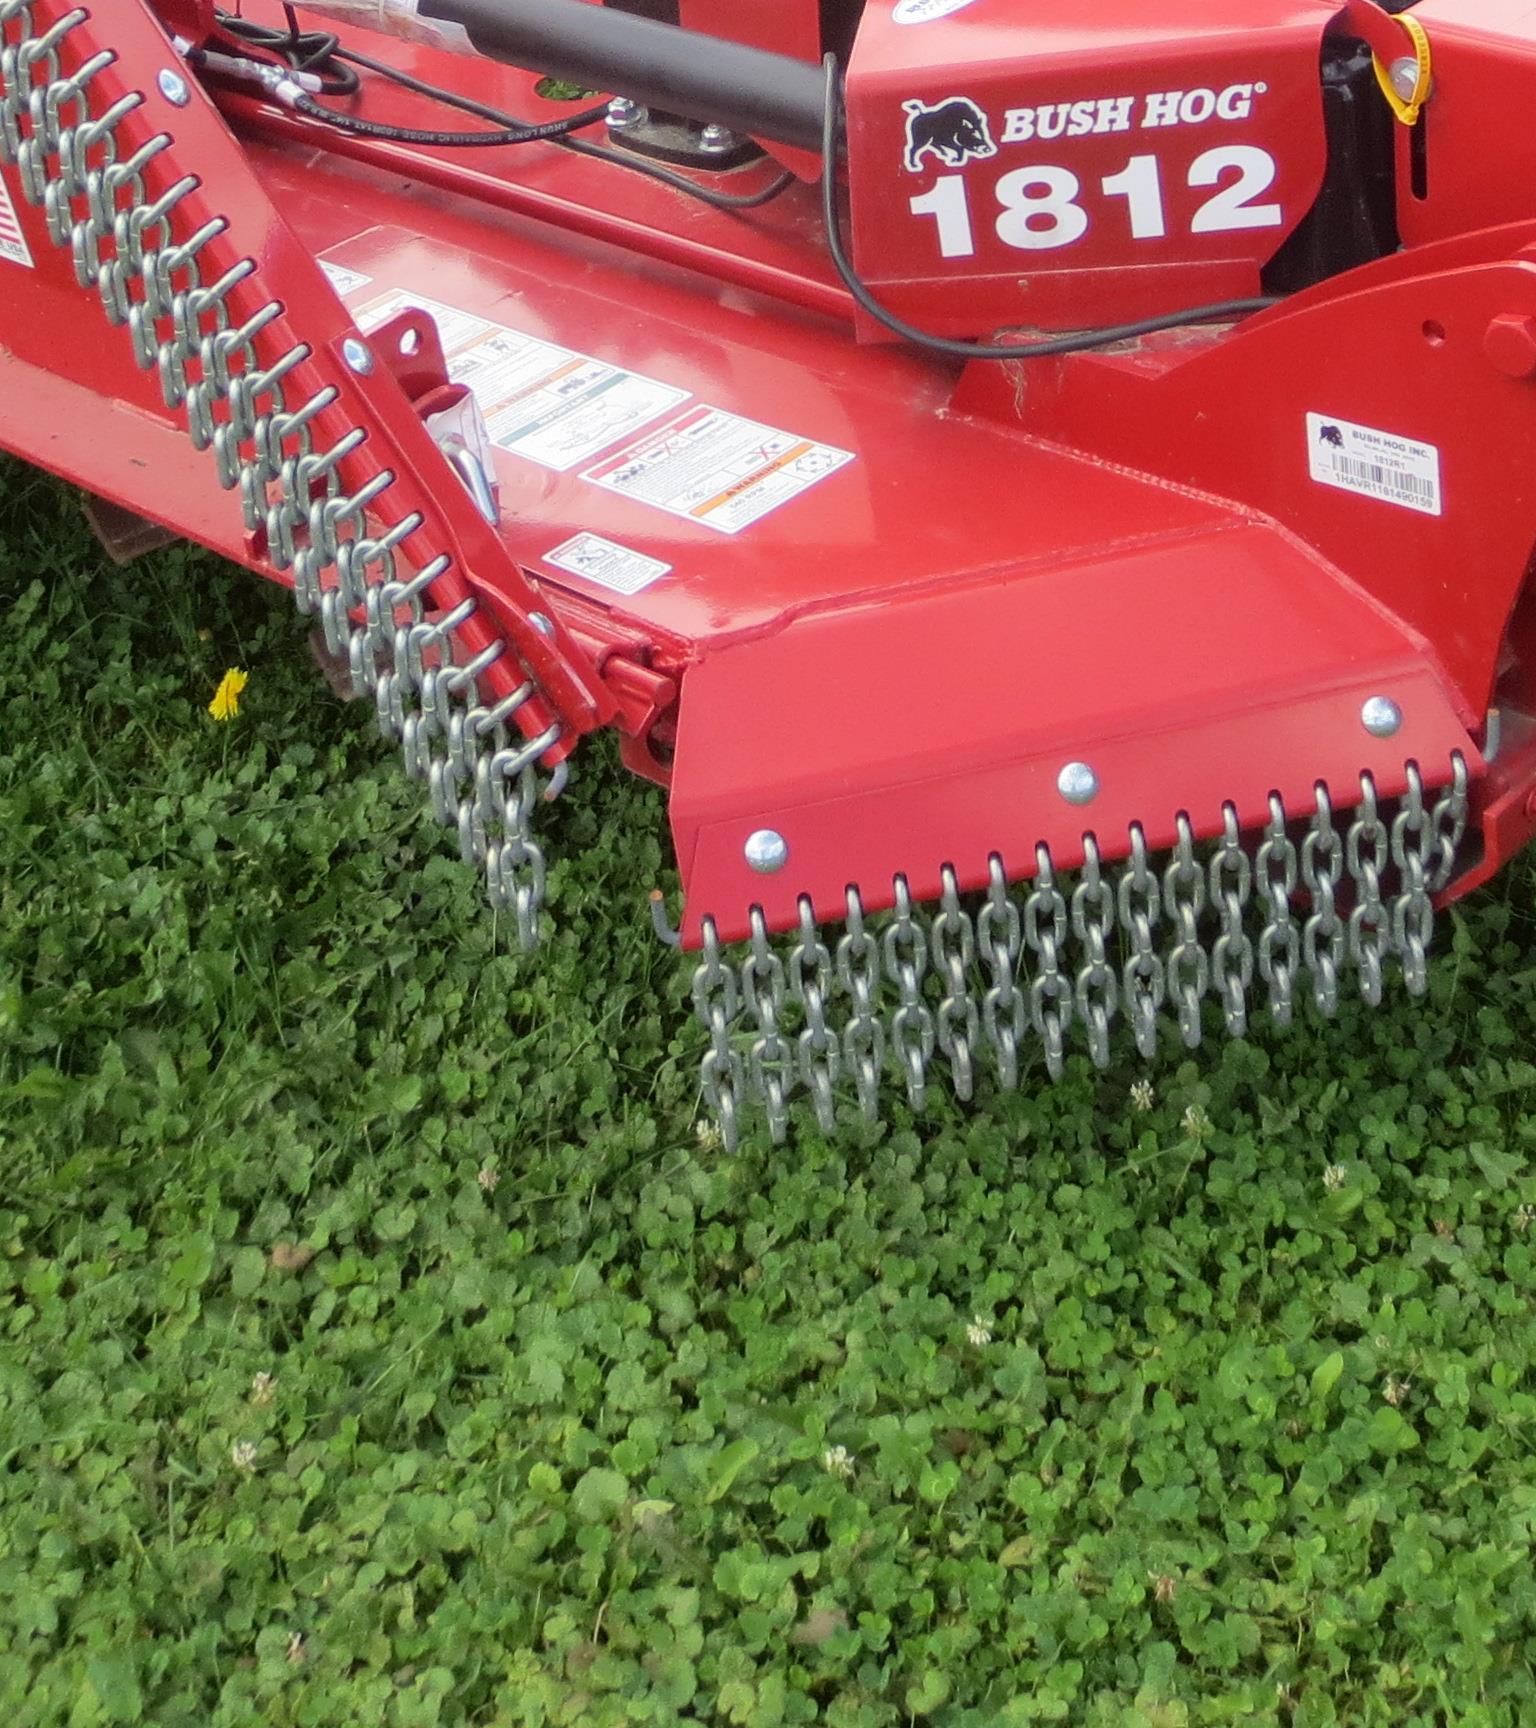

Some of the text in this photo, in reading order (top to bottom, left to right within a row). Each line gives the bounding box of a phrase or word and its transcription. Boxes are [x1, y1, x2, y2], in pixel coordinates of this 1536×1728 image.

[1000, 83, 1254, 144] BUSH HOG
[909, 144, 1283, 258] 1812
[1352, 430, 1381, 445] BUSH
[1383, 438, 1406, 452] HOG
[1408, 446, 1431, 460] INC.
[733, 460, 782, 493] WARNING
